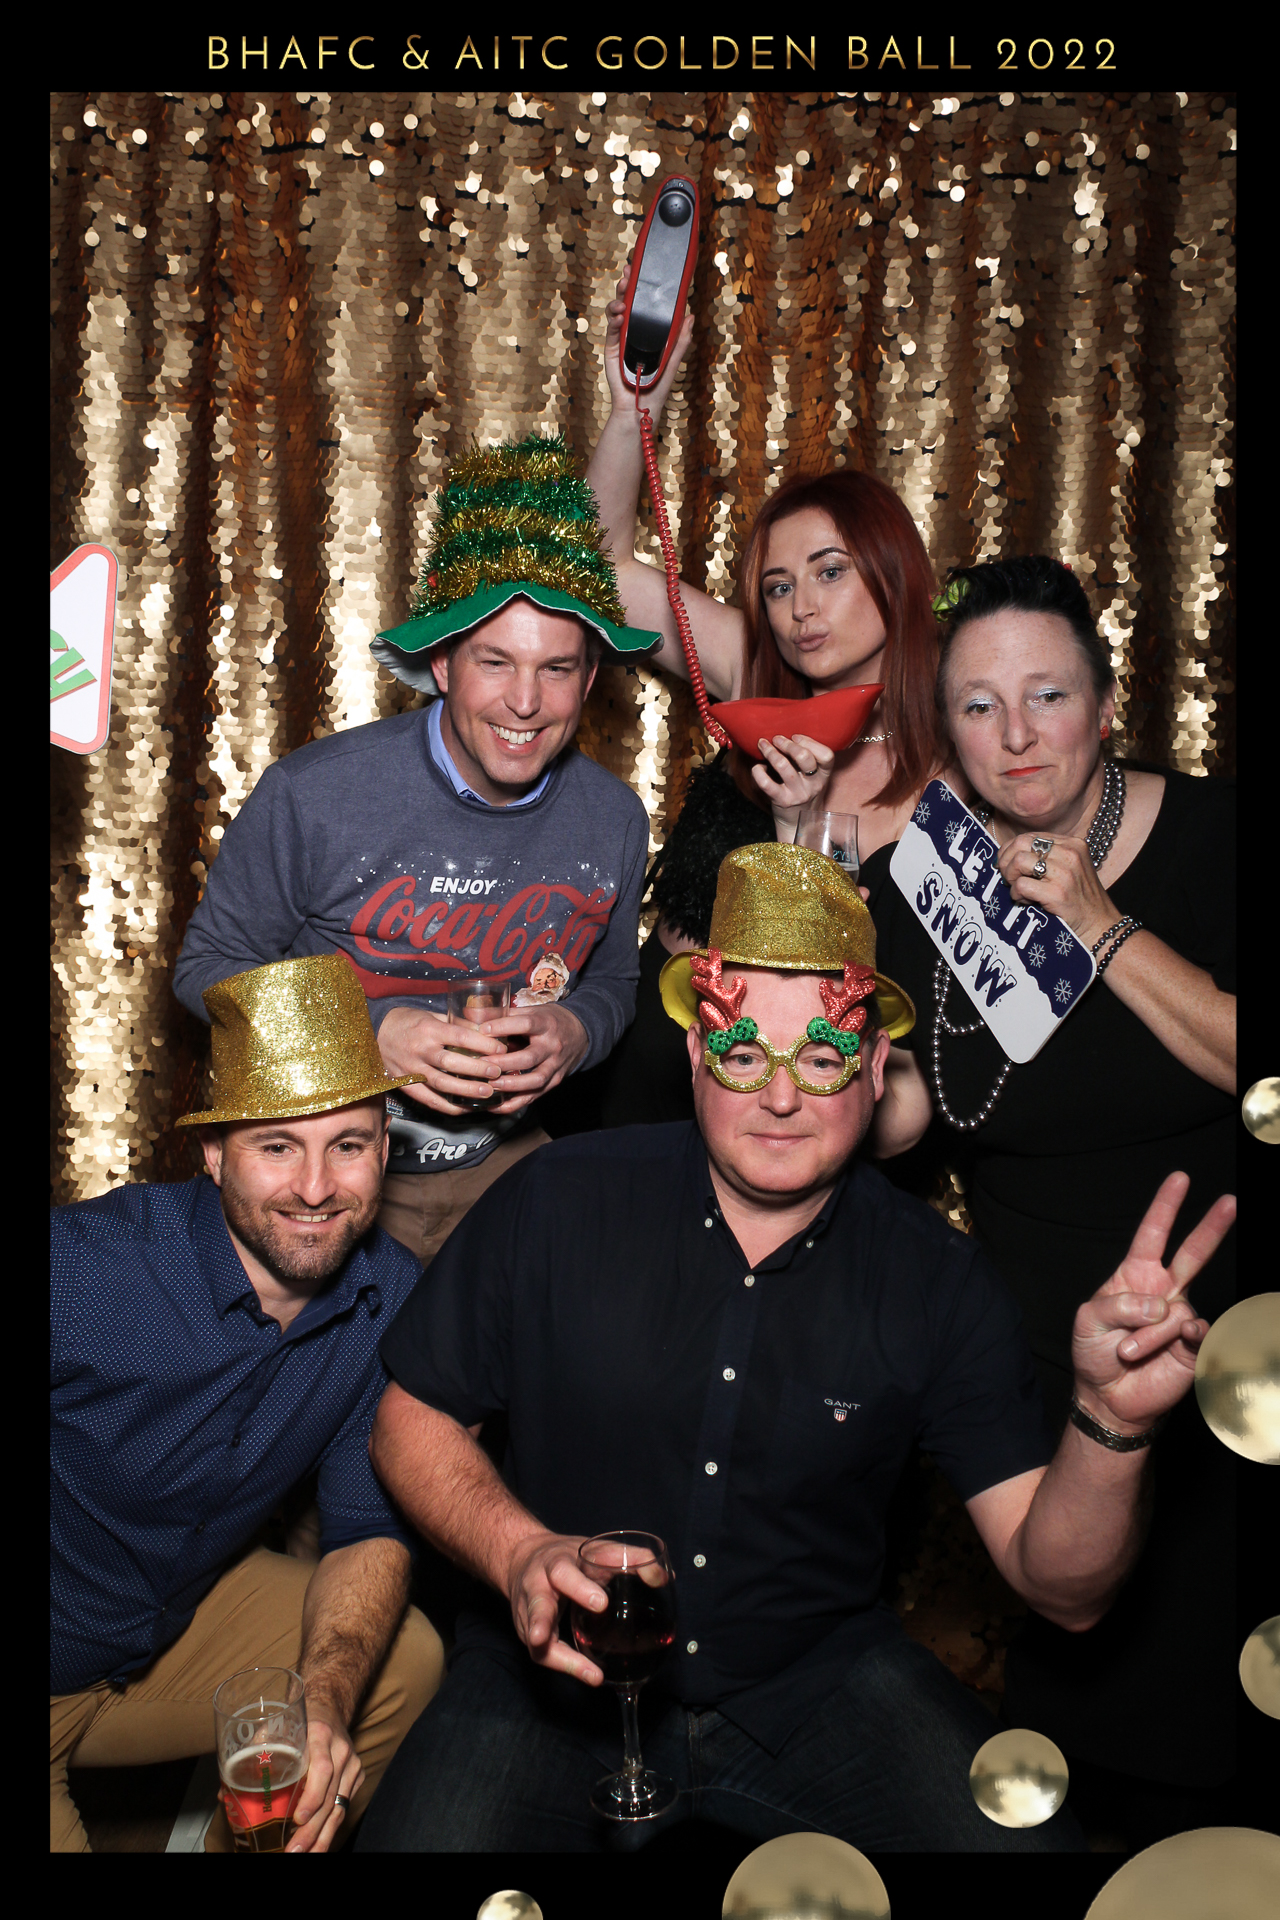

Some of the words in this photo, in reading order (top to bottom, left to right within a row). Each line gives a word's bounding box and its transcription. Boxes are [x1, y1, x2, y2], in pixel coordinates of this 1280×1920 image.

[429, 875, 498, 896] ENJOY
[948, 815, 1003, 902] LET
[915, 871, 1018, 1008] SNOW
[823, 1398, 862, 1411] GANT
